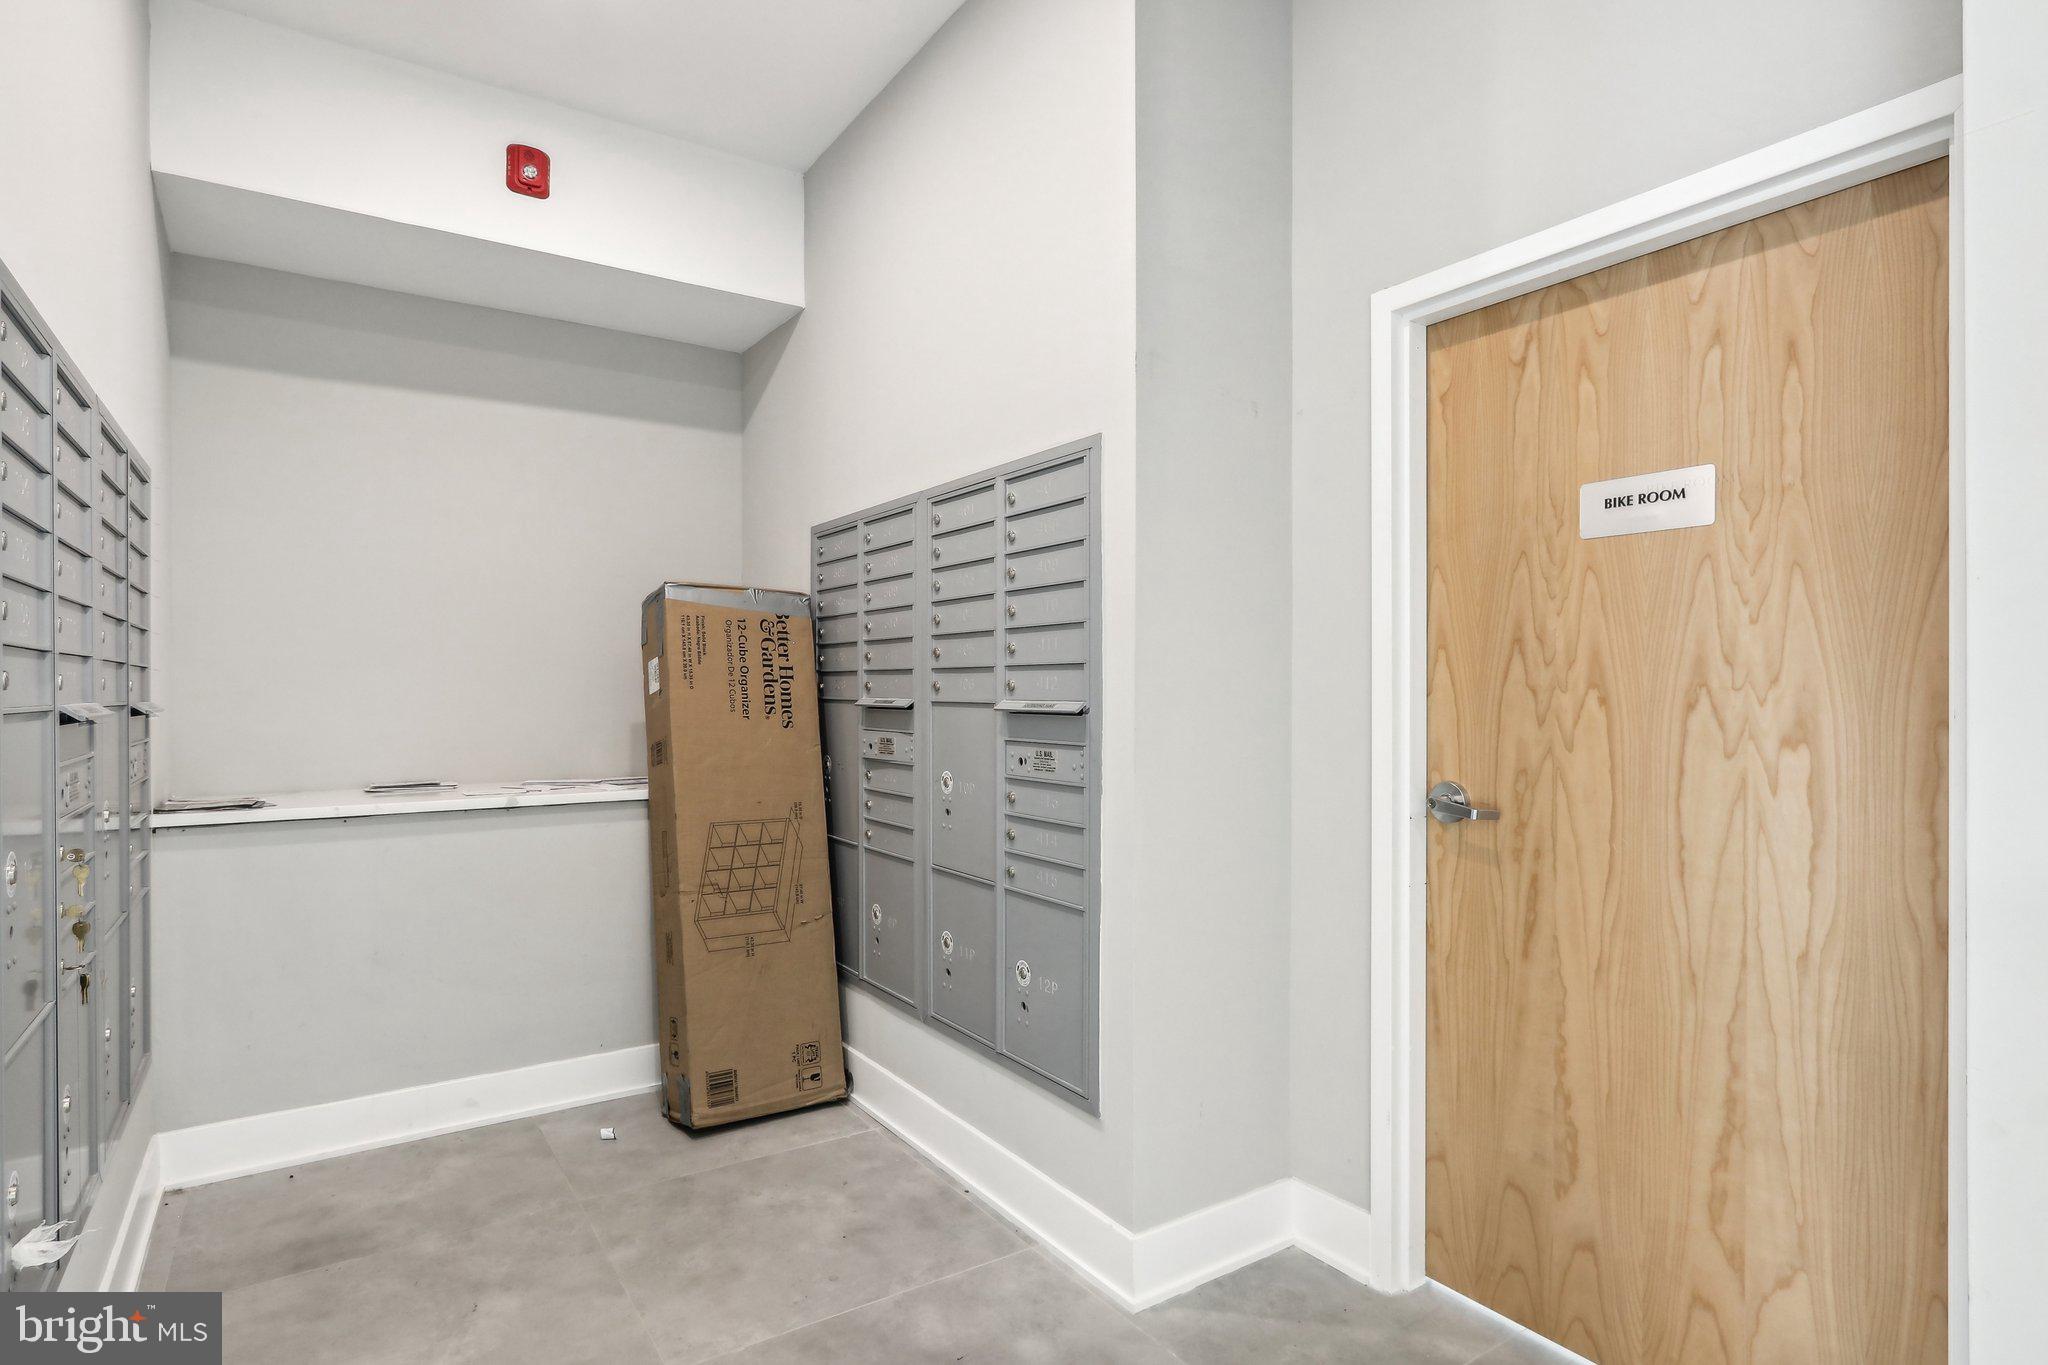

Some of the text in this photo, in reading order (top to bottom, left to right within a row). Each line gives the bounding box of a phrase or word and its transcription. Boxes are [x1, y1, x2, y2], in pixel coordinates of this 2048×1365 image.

[1604, 487, 1686, 510] BIKE ROOM
[724, 619, 737, 713] Organizador De 12 Cubos
[737, 617, 750, 720] 12-Cube Organizer
[779, 665, 794, 730] Homes
[1039, 976, 1058, 995] 12P
